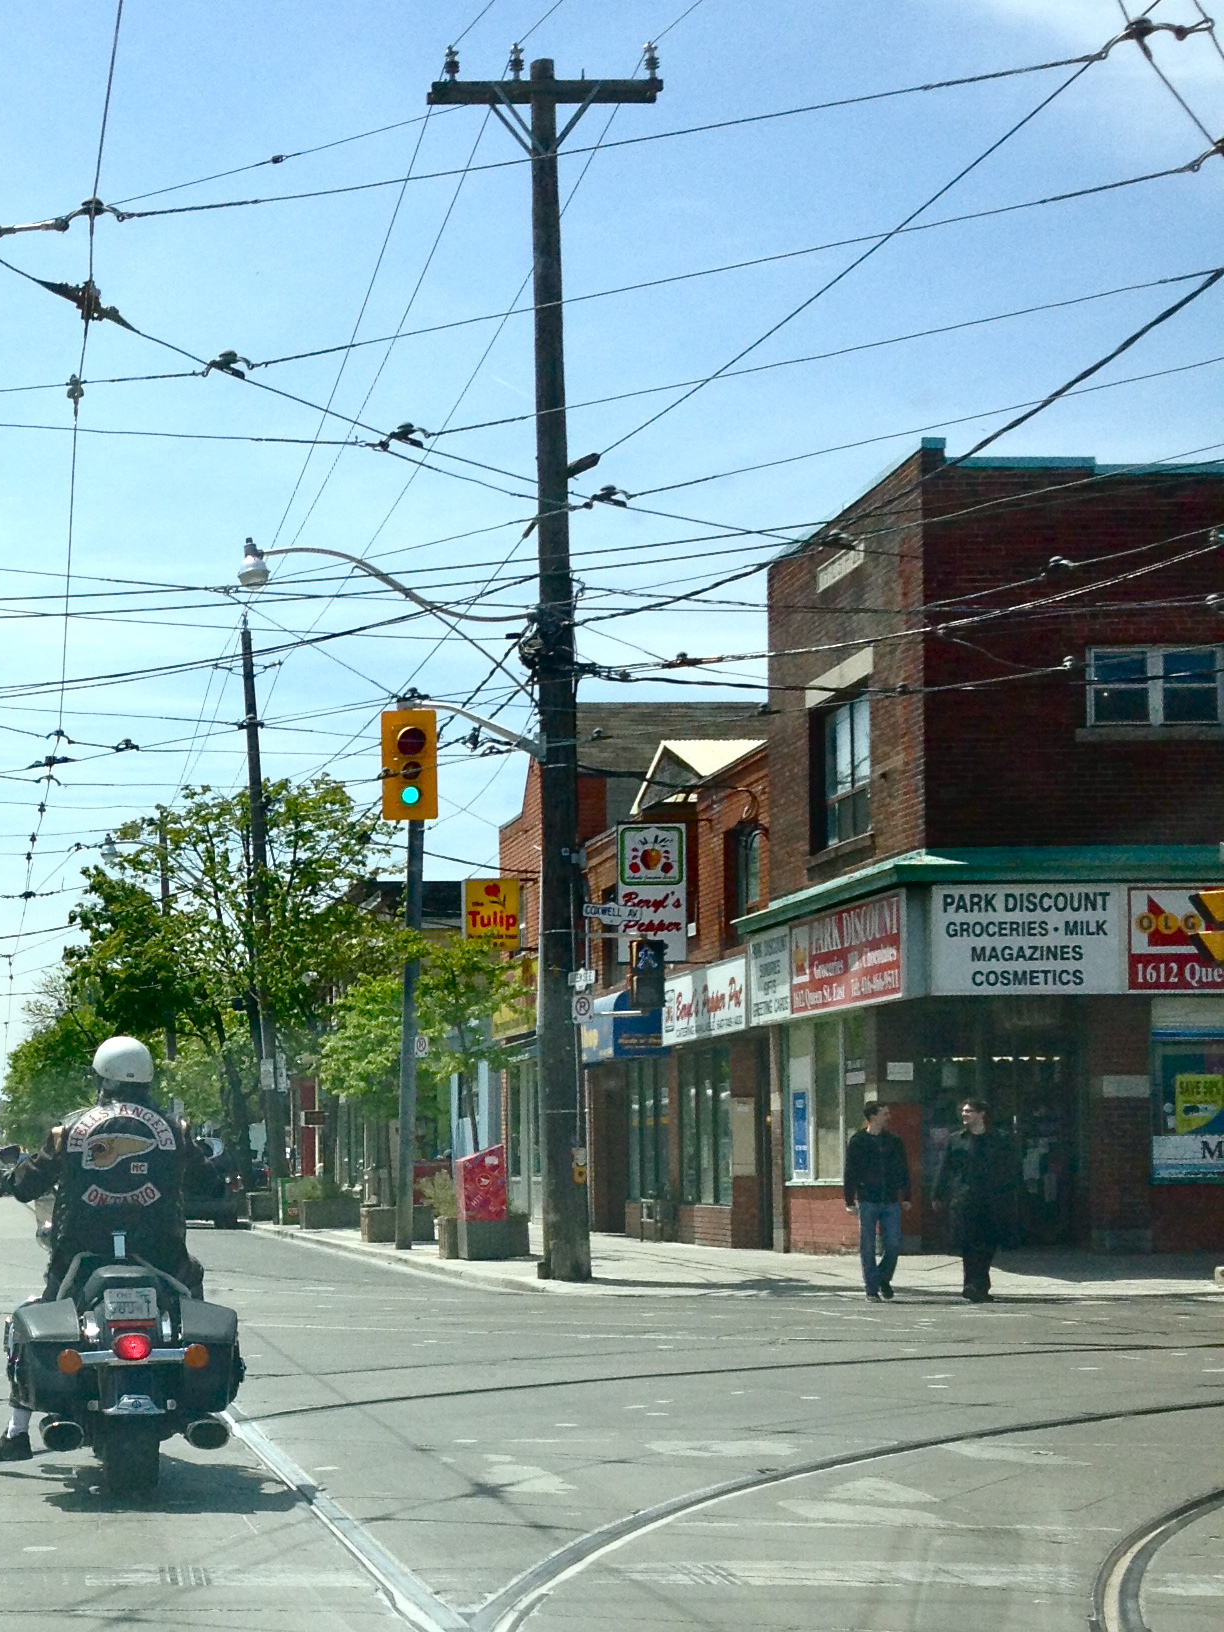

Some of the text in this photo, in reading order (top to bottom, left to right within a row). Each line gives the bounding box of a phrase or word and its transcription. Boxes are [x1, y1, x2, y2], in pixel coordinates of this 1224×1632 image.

[584, 904, 622, 918] COXWELL
[623, 891, 682, 914] Beryl's
[942, 891, 1111, 914] PARK DISCOUNT
[467, 910, 518, 931] Tulip
[623, 919, 681, 937] Pepper
[812, 897, 898, 955] PARK DISCOUNT
[945, 919, 1108, 938] GROCERIES MILK
[970, 944, 1084, 963] MAGAZINES
[971, 969, 1084, 987] COSMETICS
[1137, 962, 1179, 983] 1612
[676, 987, 699, 1026] Beryl's
[701, 983, 726, 1020] Pepper
[69, 1104, 173, 1148] HELLS ANGELS
[131, 1163, 147, 1173] MC
[87, 1186, 156, 1206] ONTARIO
